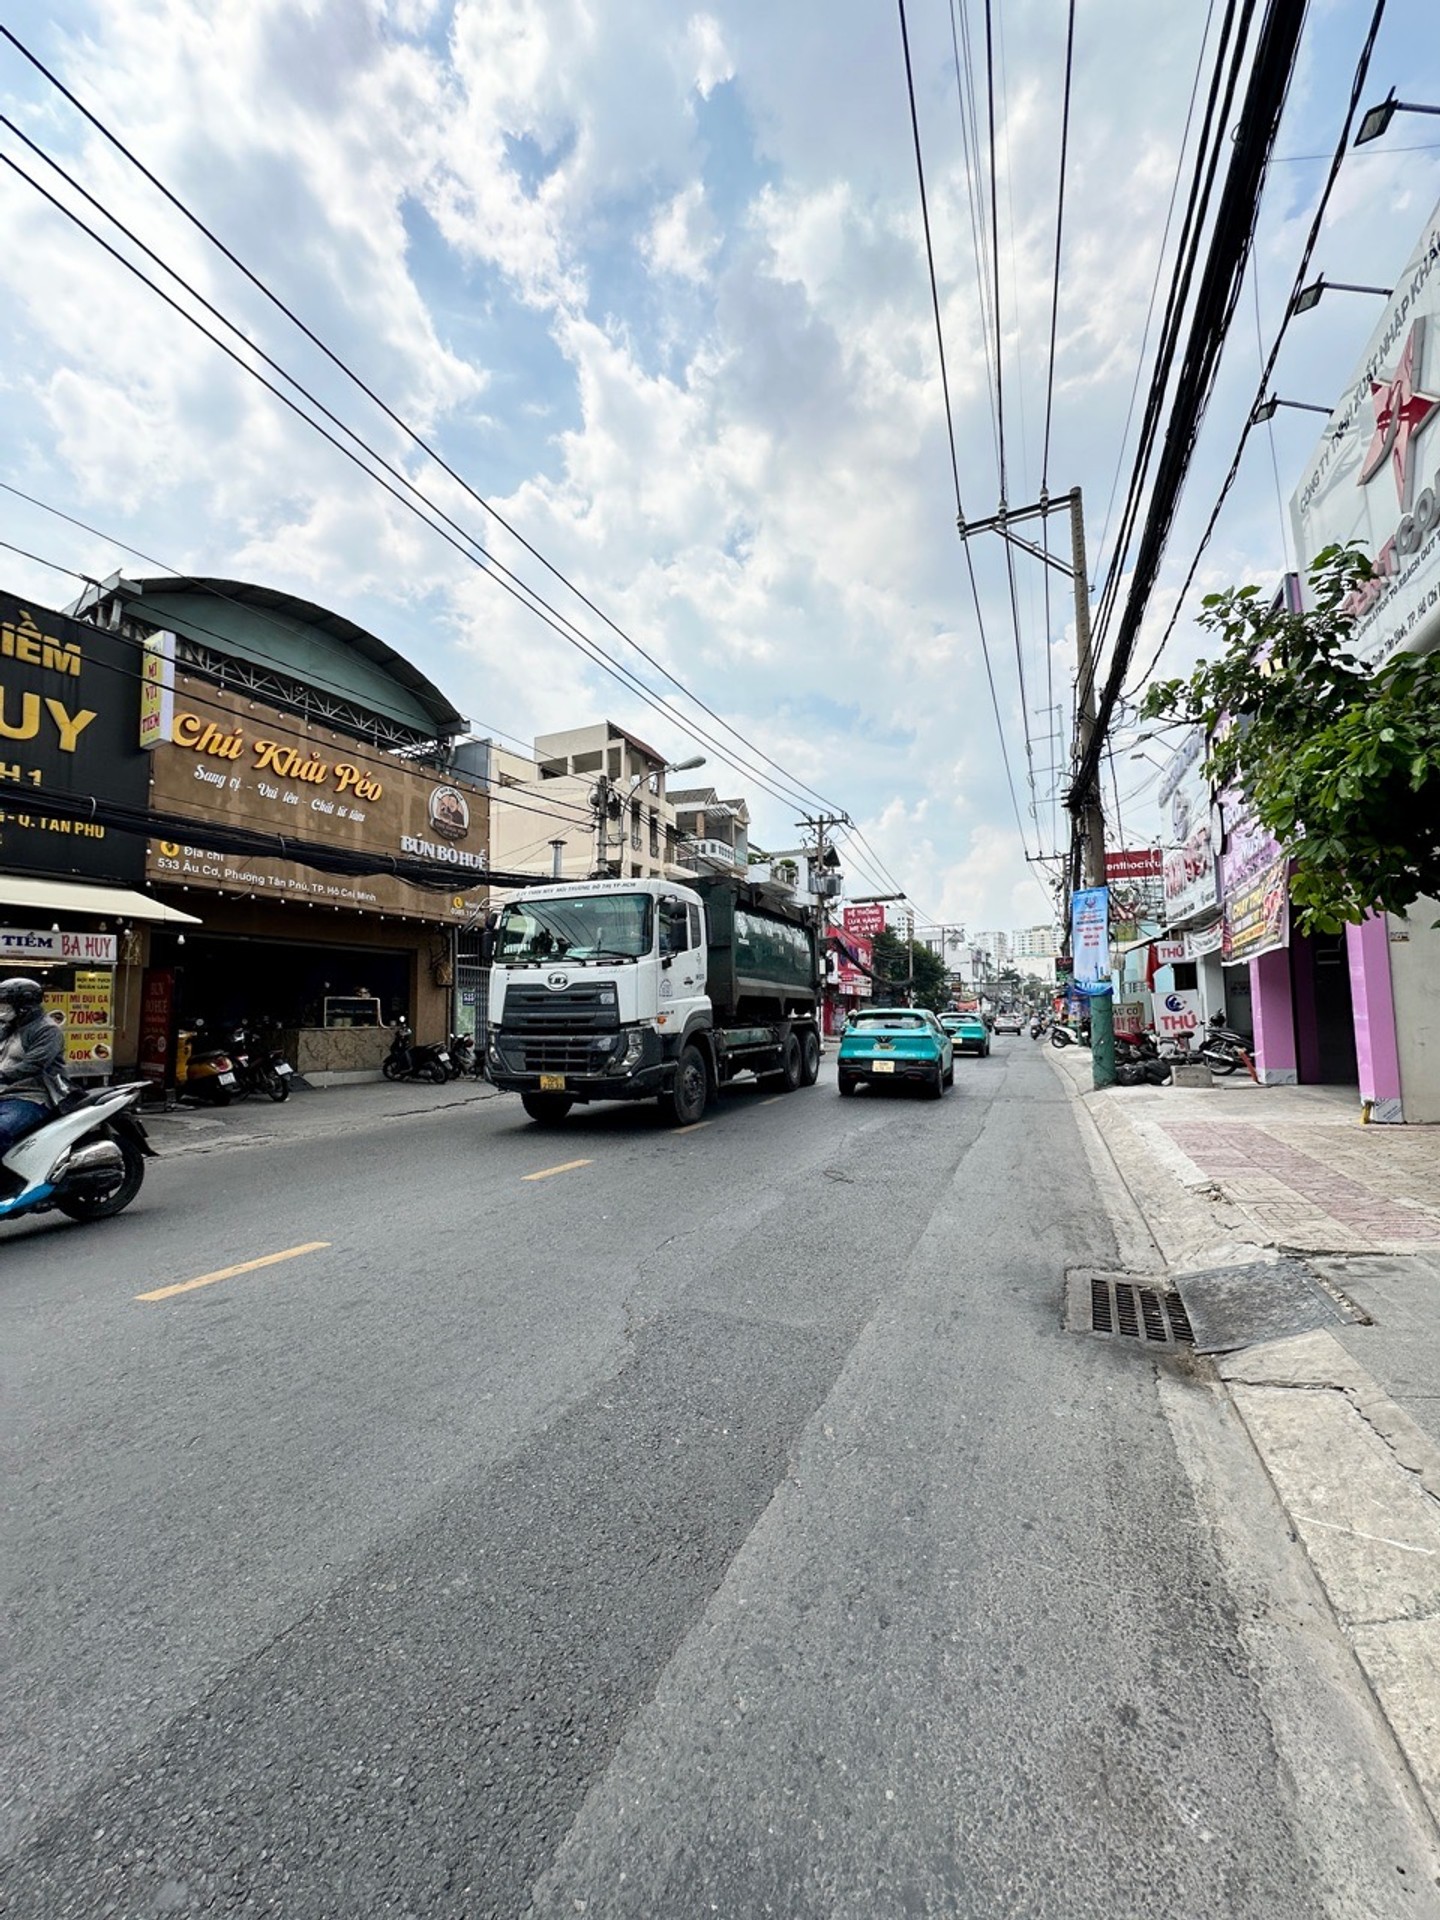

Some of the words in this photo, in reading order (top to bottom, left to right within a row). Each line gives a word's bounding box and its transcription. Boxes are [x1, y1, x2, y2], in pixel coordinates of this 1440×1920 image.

[0, 685, 98, 752] UY
[172, 713, 244, 760] Chú
[333, 762, 383, 802] Péo
[184, 846, 204, 859] Địa
[401, 833, 436, 858] BÚN
[437, 842, 458, 863] BÒ
[459, 848, 486, 869] HUẾ
[157, 857, 180, 870] 533
[182, 859, 199, 873] Âu
[267, 875, 286, 887] Tân
[312, 883, 325, 894] TP.
[327, 886, 340, 896] Hồ
[357, 891, 377, 902] Minh
[62, 934, 81, 956] BA
[85, 936, 111, 958] HUY
[1160, 945, 1185, 958] THÚ
[69, 1011, 93, 1024] 70K
[1160, 1010, 1197, 1030] THÚ
[69, 1050, 91, 1060] 40K
